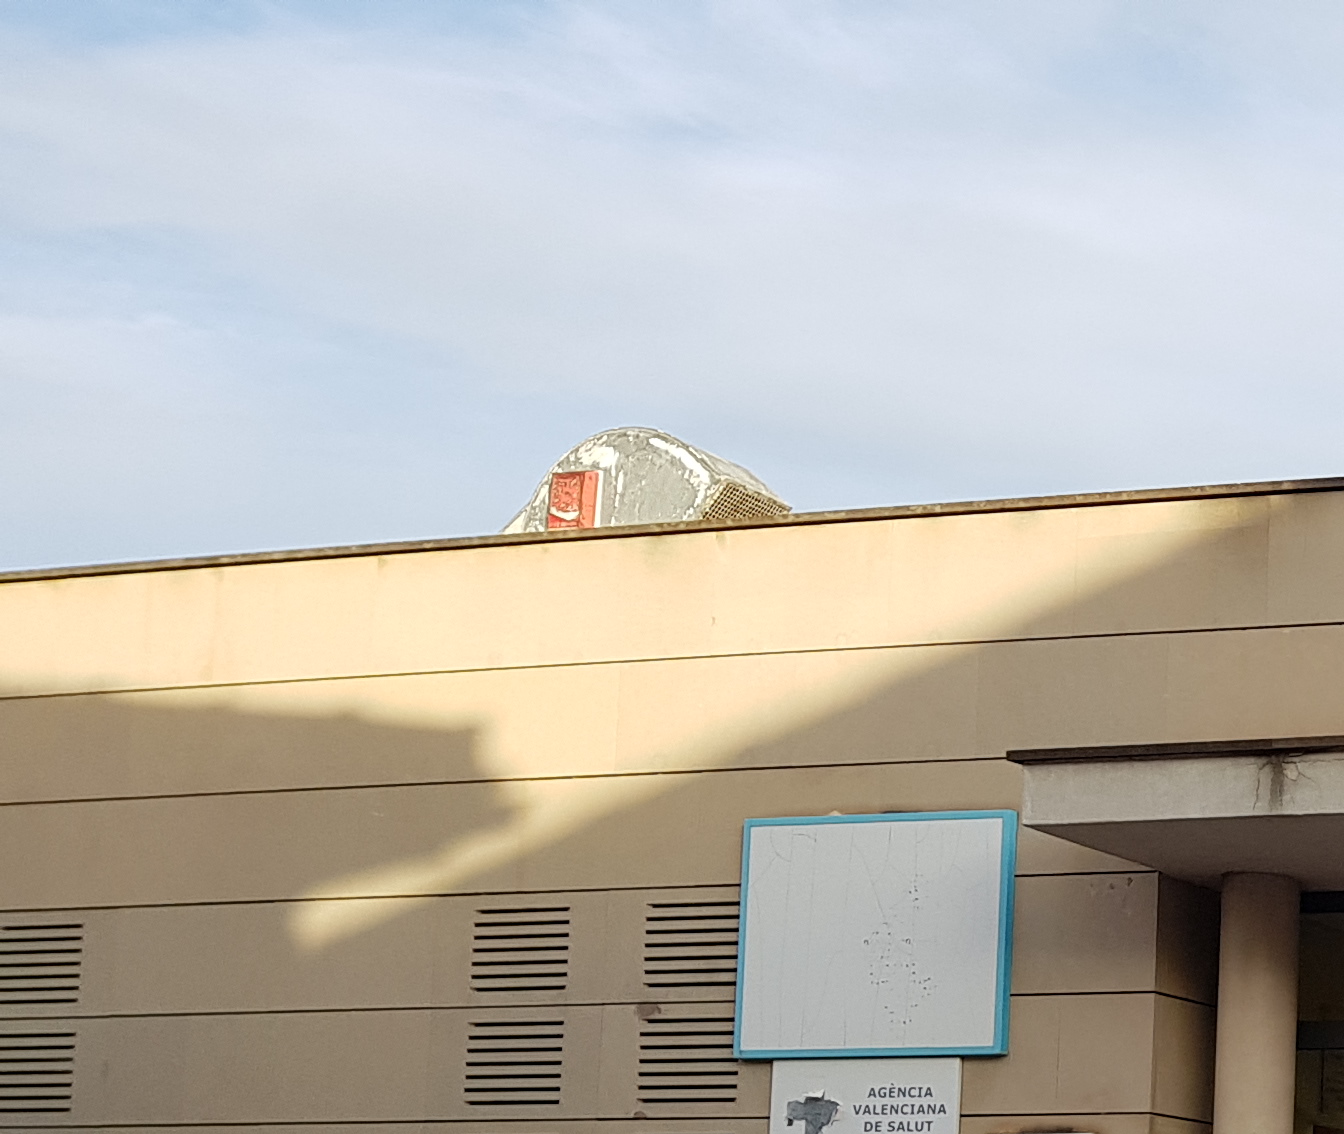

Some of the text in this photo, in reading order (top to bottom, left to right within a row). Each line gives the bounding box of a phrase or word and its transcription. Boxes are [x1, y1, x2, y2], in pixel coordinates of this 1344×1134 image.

[867, 1083, 933, 1098] AGÈNCIA
[853, 1103, 947, 1115] VALENCIANA
[863, 1120, 933, 1132] DE SALUT
